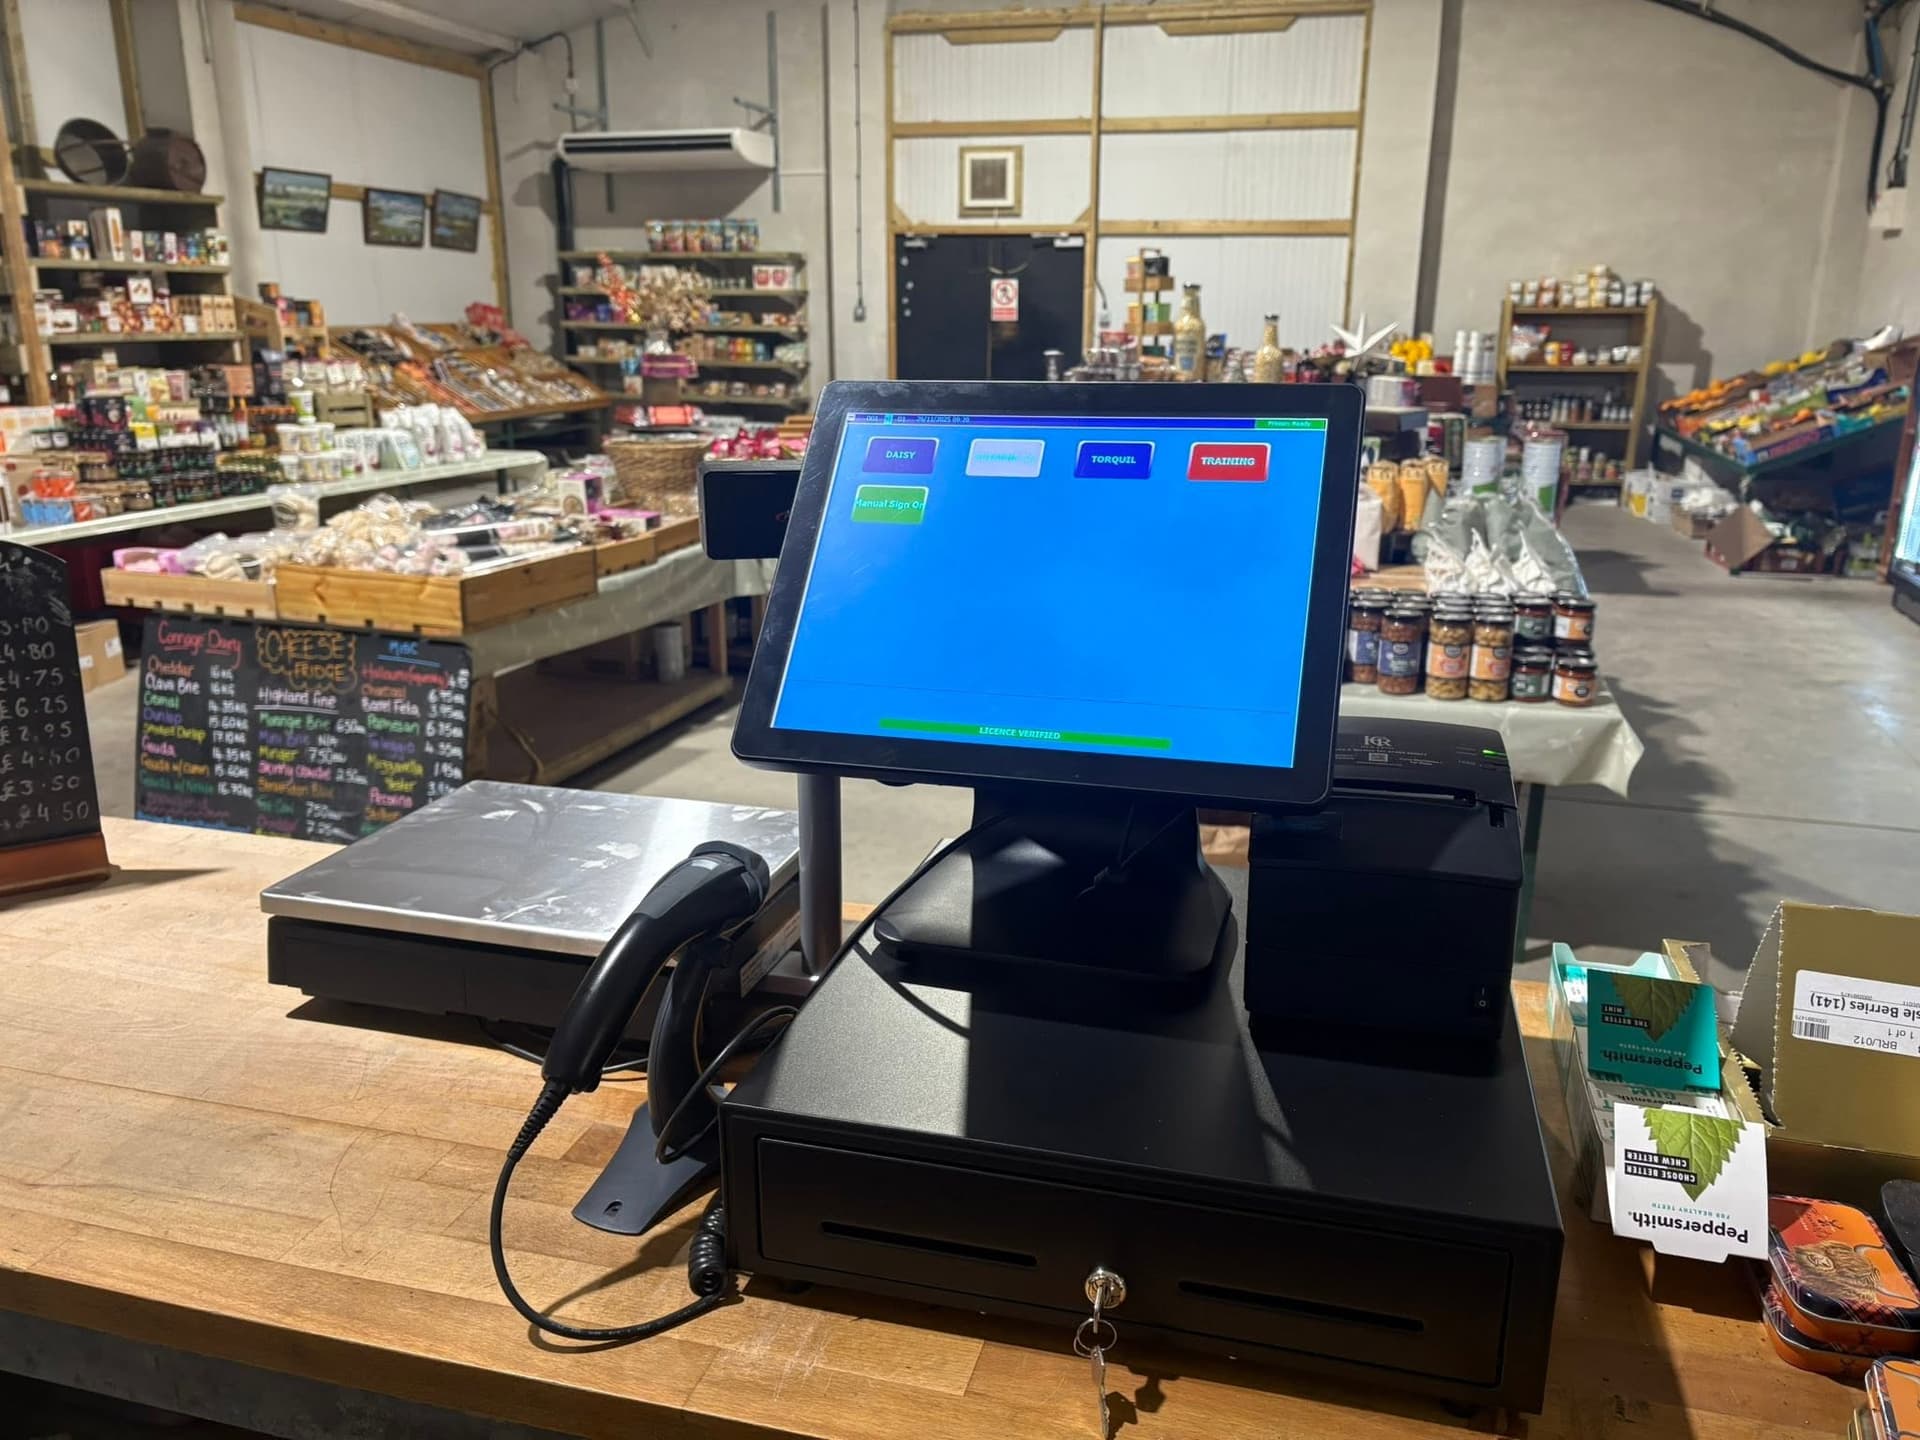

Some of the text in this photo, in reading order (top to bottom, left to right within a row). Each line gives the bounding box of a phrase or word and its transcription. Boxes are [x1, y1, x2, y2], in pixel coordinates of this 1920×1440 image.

[885, 449, 917, 461] DAISY
[1091, 454, 1137, 466] TORQUIL
[1200, 455, 1256, 468] TRAINING
[888, 499, 910, 511] Sign
[265, 630, 346, 661] CHEESE
[148, 655, 195, 677] Cheddar
[295, 661, 346, 682] FRIDGE
[177, 676, 201, 696] Brie
[258, 687, 337, 710] Highland Fine
[978, 726, 1061, 741] LICENCE VERIFIED
[141, 735, 177, 758] Gouda
[1809, 992, 1846, 1011] (141)
[1849, 1000, 1899, 1019] Berries
[1603, 1014, 1650, 1028] THE BETTER
[1895, 1029, 1906, 1038] of
[1853, 1035, 1898, 1050] BRL/012
[1626, 1151, 1688, 1168] CHEW BETTER
[1626, 1164, 1697, 1183] CHOOSE BETTER
[1651, 1202, 1731, 1220] FOR HEALTHY TEETH
